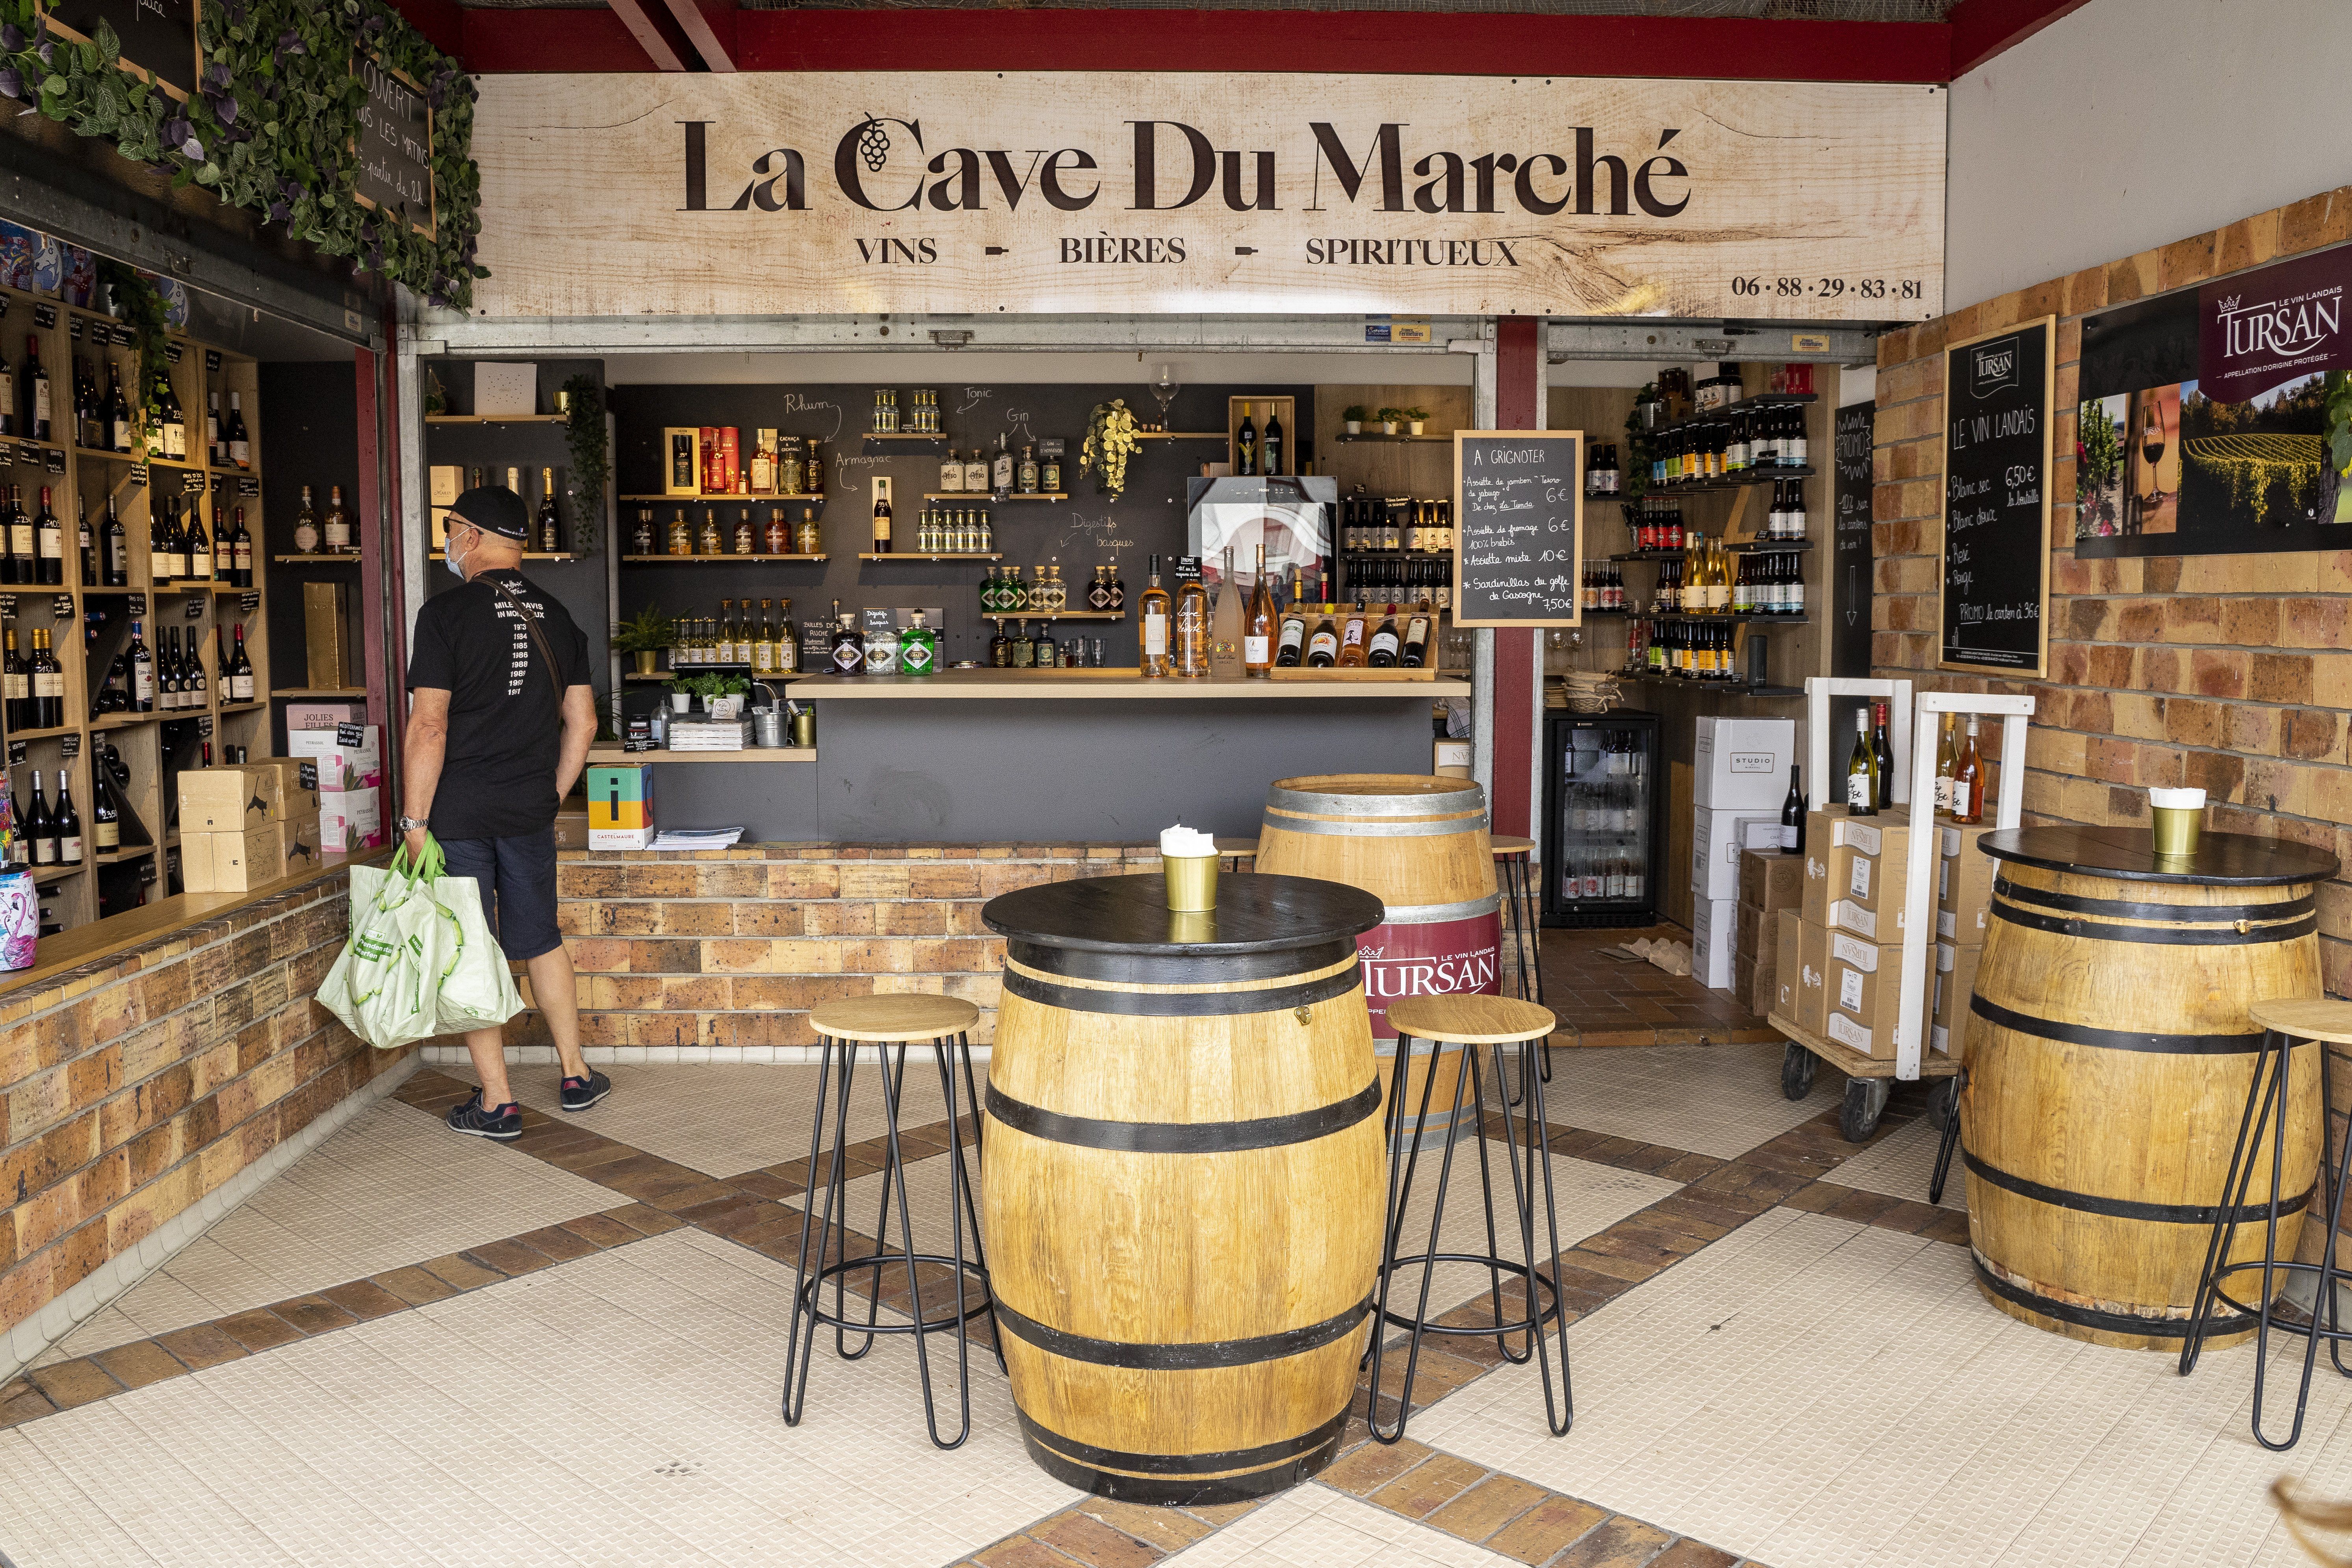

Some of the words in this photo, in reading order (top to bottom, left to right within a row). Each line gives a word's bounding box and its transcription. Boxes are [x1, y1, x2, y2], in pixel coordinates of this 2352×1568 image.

[364, 60, 415, 122] OUVERT
[357, 107, 373, 127] OUS
[380, 118, 397, 147] LES
[402, 134, 429, 169] MATINS
[674, 120, 813, 212] La
[834, 118, 1101, 212] Cave
[1123, 121, 1283, 212] Du
[1301, 122, 1691, 218] Marché
[397, 170, 408, 197] de
[852, 238, 937, 263] VINS
[1058, 230, 1186, 263] BIÈRES
[1305, 237, 1521, 266] SPIRITUEUX
[2279, 298, 2289, 307] LE
[2291, 295, 2304, 304] VIN
[2306, 286, 2343, 300] LANDAIS
[2217, 296, 2343, 358] TURSAN
[1976, 354, 2012, 377] TURSAN
[2224, 366, 2261, 379] APPELLATION
[2263, 360, 2293, 372] D'ORIGINE
[2294, 353, 2328, 366] PROTÉGÉE
[963, 386, 993, 399] Tonic
[784, 393, 835, 414] Rhum
[1006, 408, 1028, 421] Gin
[1954, 419, 1966, 450] LE
[1971, 410, 1990, 443] VIN
[1996, 404, 2035, 438] LANDAIS
[1840, 432, 1866, 458] PROMO
[835, 452, 891, 469] Armagnac
[1474, 449, 1483, 466] A
[1491, 446, 1544, 464] GRIGNOTER
[1466, 476, 1494, 488] Assiette
[1506, 477, 1532, 491] jambon
[2005, 466, 2036, 489] 6,50€
[1546, 488, 1569, 503] 6€
[1951, 476, 1976, 502] Blanc
[1978, 479, 1991, 494] sec
[1472, 503, 1482, 511] De
[1070, 512, 1117, 535] Digestifs
[1466, 525, 1495, 537] Assiette
[1509, 523, 1539, 537] fromage
[1548, 517, 1569, 532] 6€
[1952, 510, 1974, 533] Blanc
[1096, 534, 1134, 556] basques
[1468, 540, 1489, 550] 100%
[1490, 537, 1515, 546] brebis
[1952, 543, 1970, 564] Rosé
[1470, 554, 1502, 566] Assiette
[1505, 551, 1531, 562] mixte
[1538, 549, 1568, 562] 10€
[1473, 577, 1530, 590] Sardinillas
[1534, 576, 1547, 586] du
[1550, 574, 1570, 591] golfe
[1953, 570, 1974, 595] Rouge
[1489, 592, 1500, 601] de
[1502, 590, 1543, 605] Gascogne
[1542, 598, 1572, 612] 7,50€
[866, 610, 887, 619] Digestifs
[1959, 603, 1984, 620] PROMO
[1986, 603, 1993, 620] le
[1994, 604, 2015, 620] carton
[2016, 603, 2022, 620] à
[2023, 602, 2040, 618] 36€
[869, 619, 889, 627] basques
[1470, 946, 1495, 958] LANDAIS
[1359, 954, 1495, 997] TURSAN
